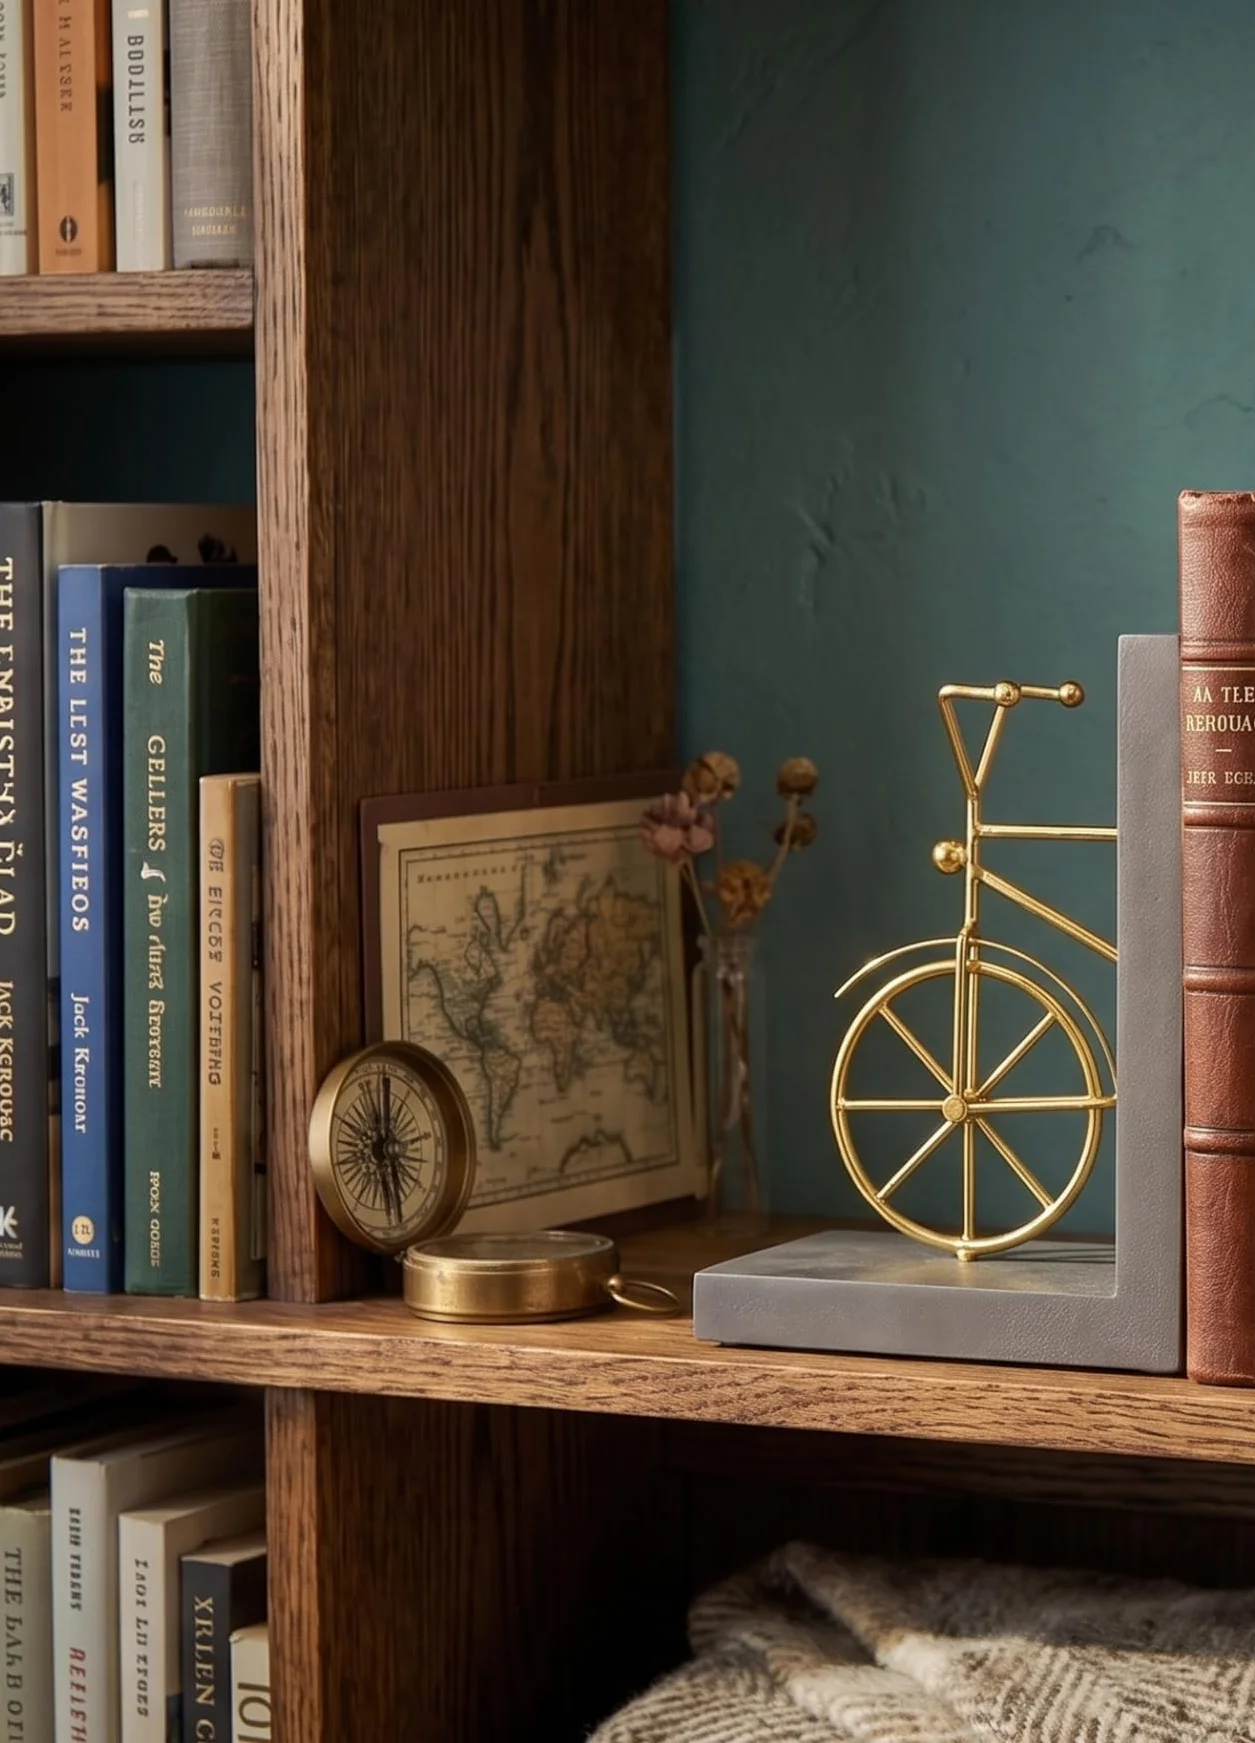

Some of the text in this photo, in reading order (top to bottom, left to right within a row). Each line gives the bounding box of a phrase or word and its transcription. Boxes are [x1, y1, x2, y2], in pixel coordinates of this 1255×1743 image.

[70, 628, 87, 684] THE
[148, 639, 166, 686] The
[147, 734, 167, 852] GELLERS
[4, 1547, 23, 1607] THE
